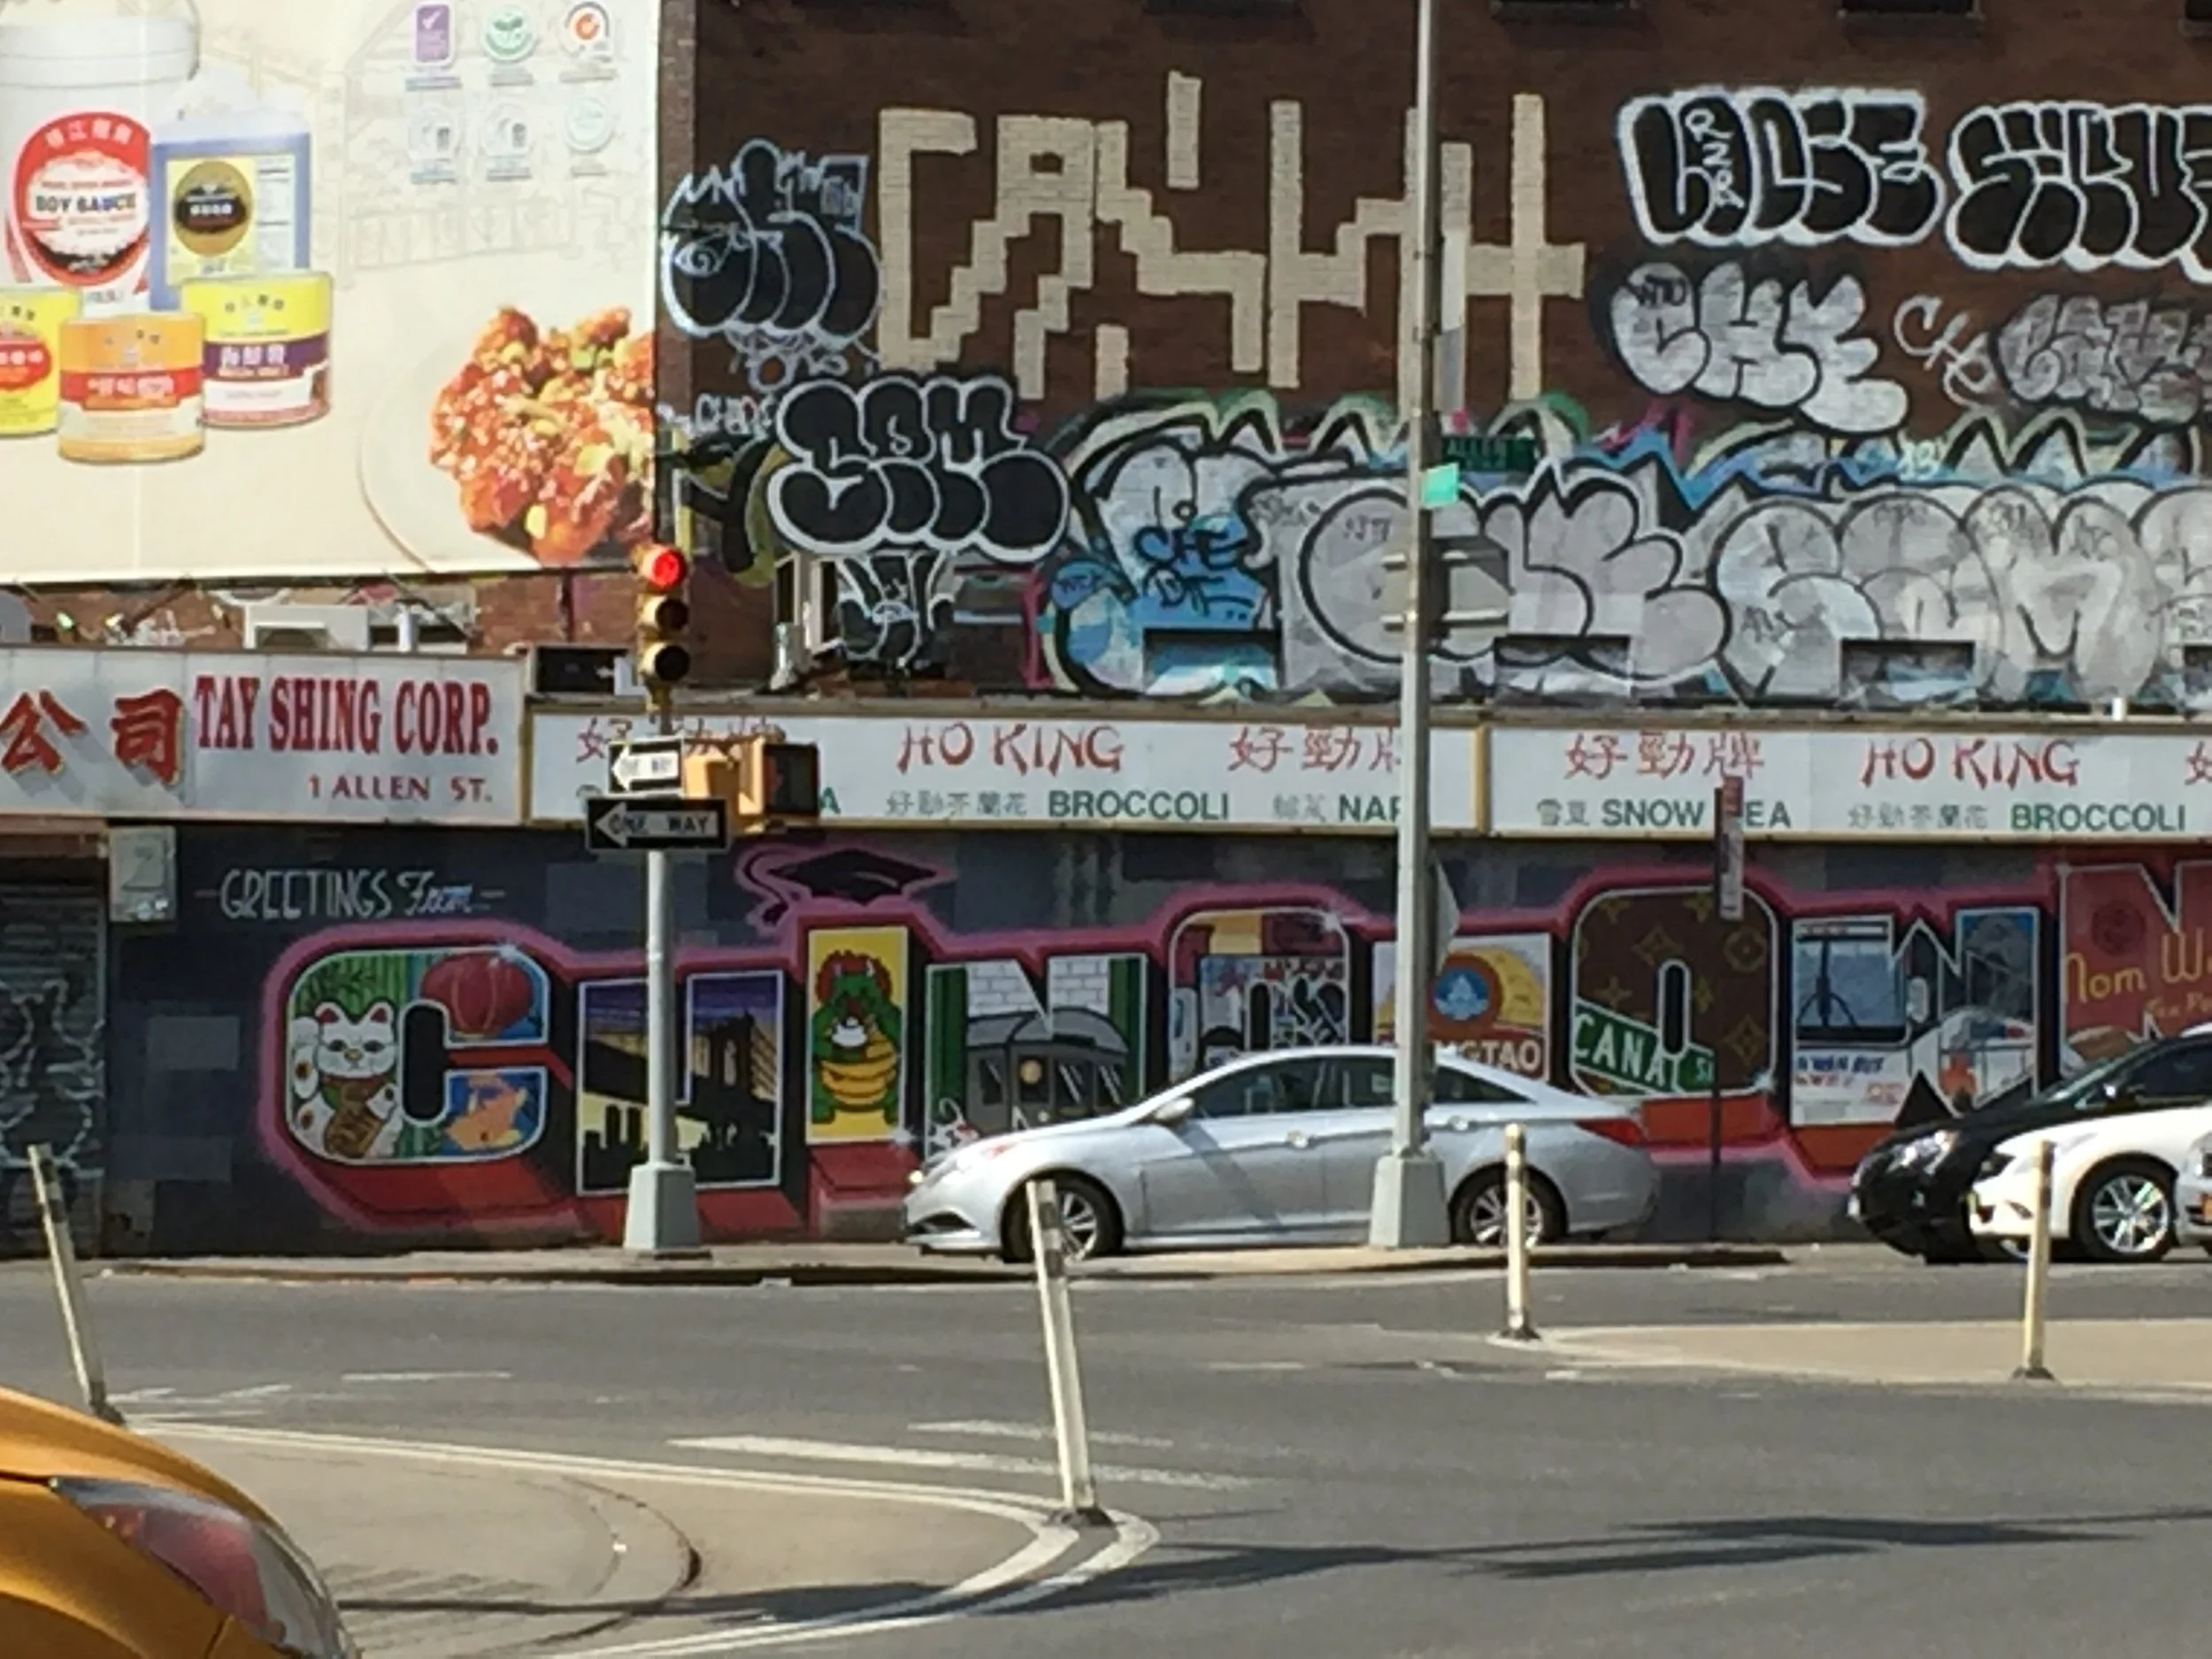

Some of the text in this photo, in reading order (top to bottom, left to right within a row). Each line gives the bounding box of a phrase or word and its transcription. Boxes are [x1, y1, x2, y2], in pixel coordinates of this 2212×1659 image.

[195, 676, 260, 749] TAY
[269, 677, 382, 754] SHING
[396, 680, 499, 755] CORP.
[0, 689, 183, 786] 公司
[896, 721, 1125, 777] HO KING
[1860, 737, 2080, 790] HO KING
[309, 774, 494, 802] 1 ALLEN ST.
[1048, 789, 1229, 820] BROCCOLI
[668, 817, 709, 836] WAY
[1601, 798, 1790, 827] SNOW EA
[2010, 803, 2186, 832] BROCCOLI
[219, 867, 393, 919] GREETINGS
